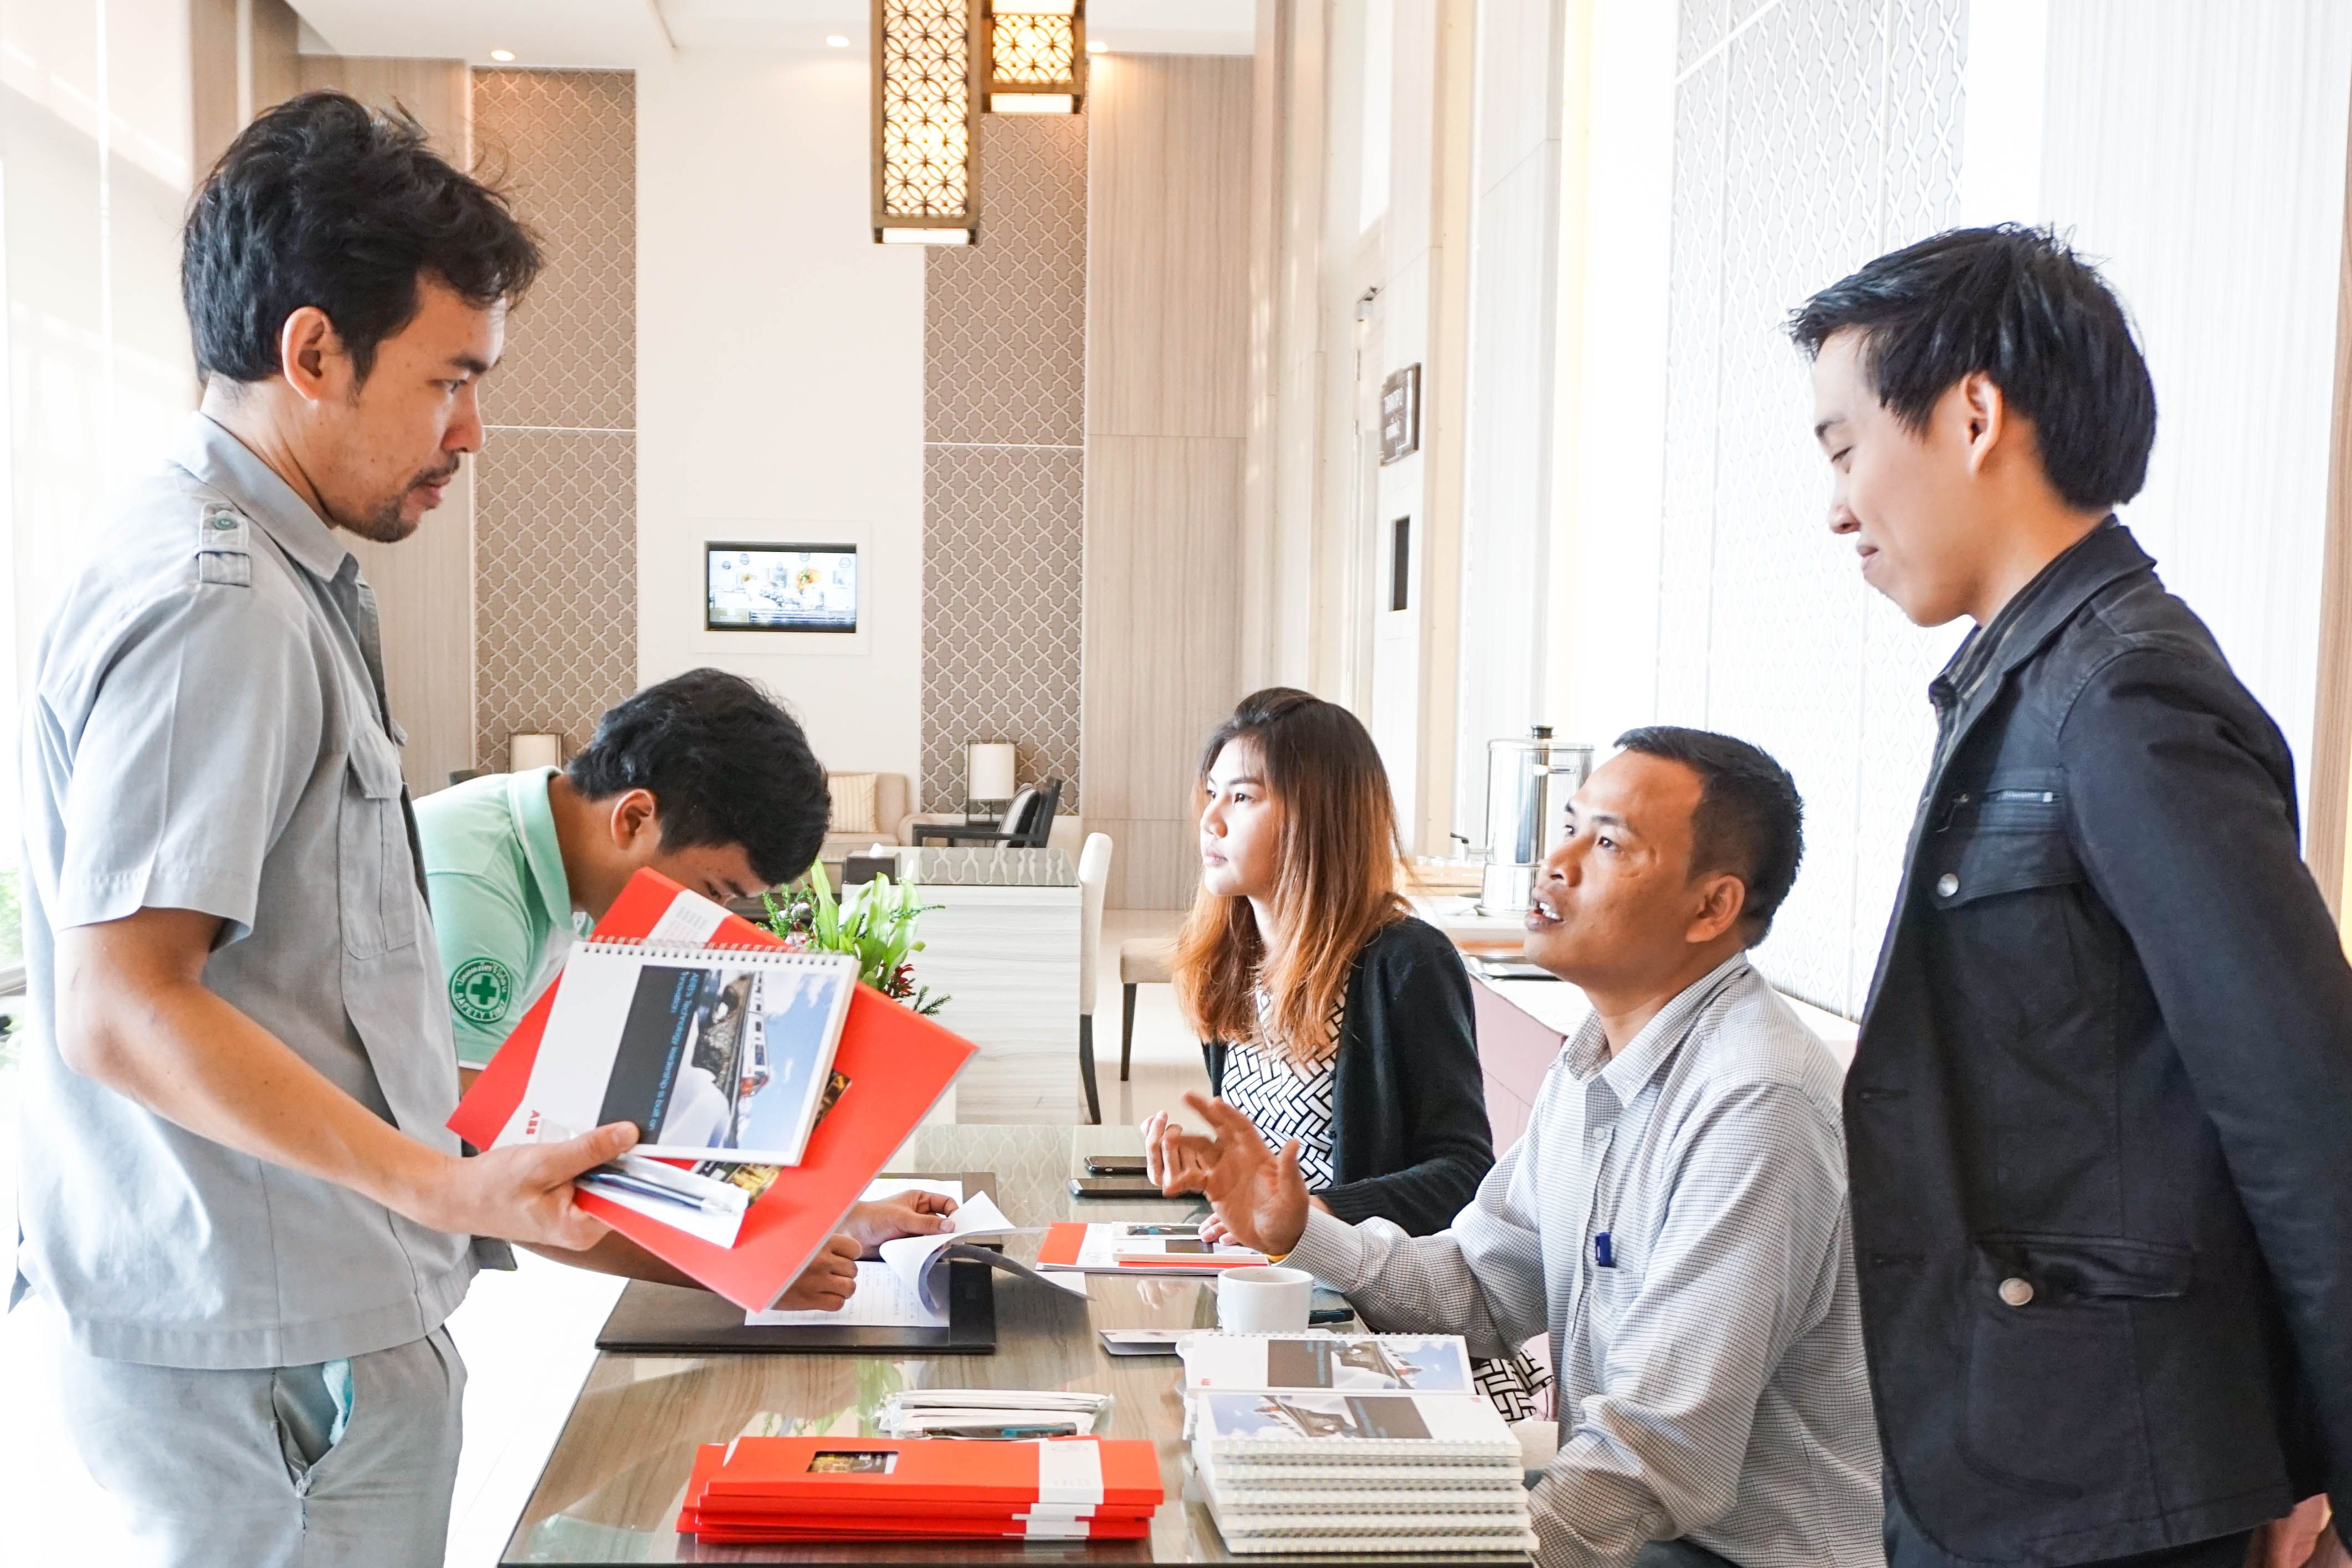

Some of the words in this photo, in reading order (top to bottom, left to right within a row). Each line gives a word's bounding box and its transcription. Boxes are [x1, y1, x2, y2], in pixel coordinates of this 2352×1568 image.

[454, 992, 486, 1019] SAFETY
[489, 998, 506, 1019] FIT
[526, 1109, 541, 1135] ABB
